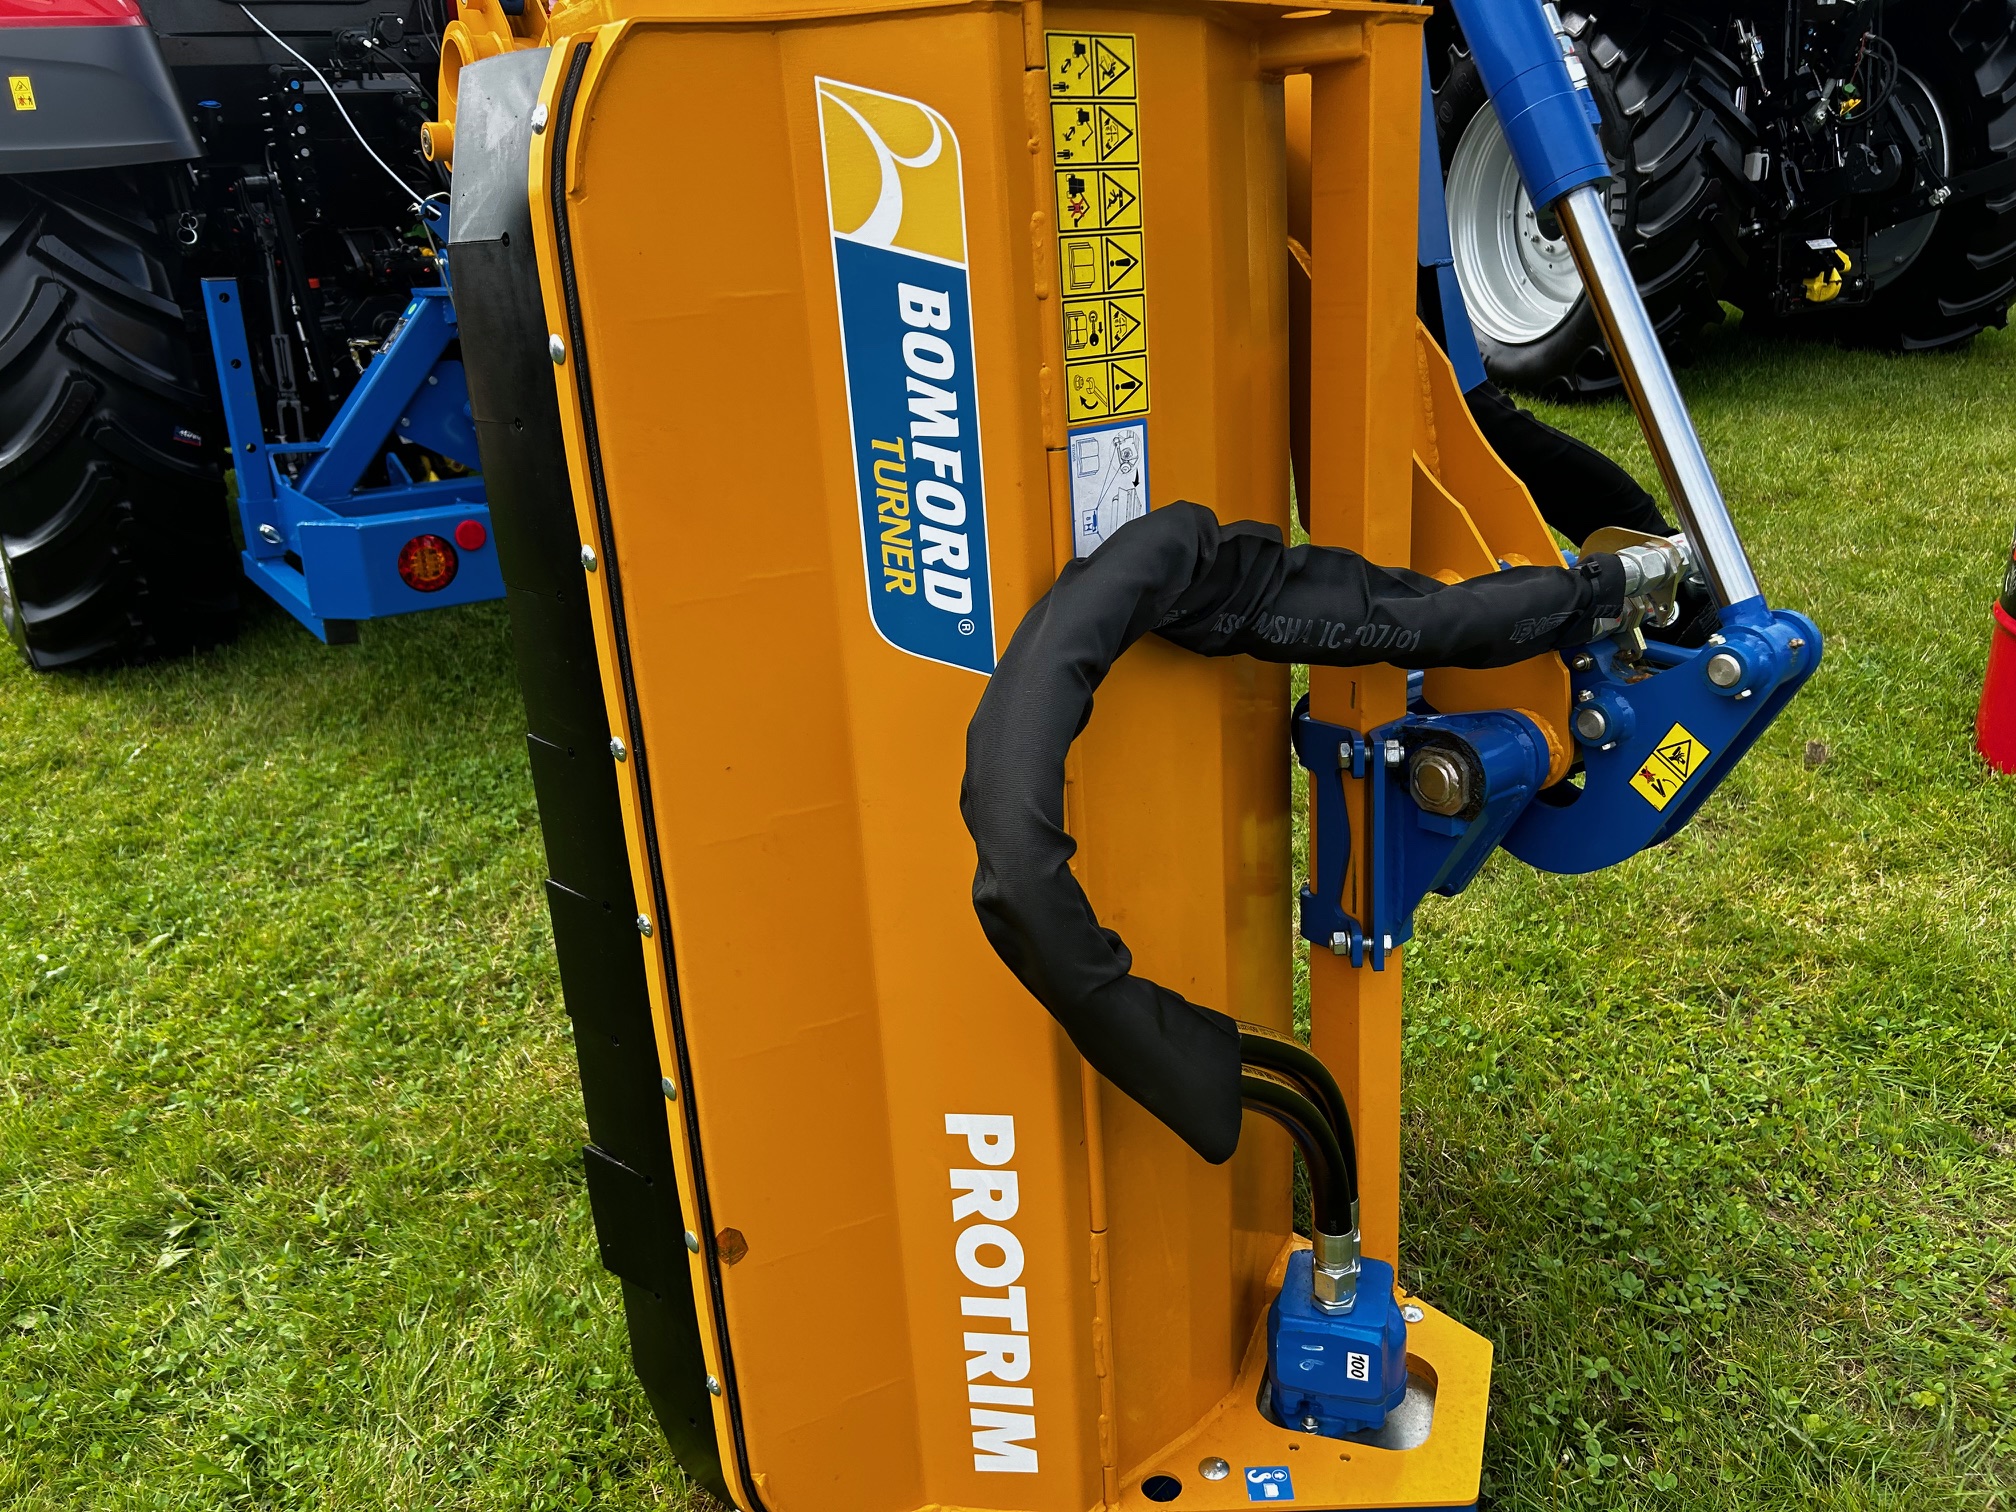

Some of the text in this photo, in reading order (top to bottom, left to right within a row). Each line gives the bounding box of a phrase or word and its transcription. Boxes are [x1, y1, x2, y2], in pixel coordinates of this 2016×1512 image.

[871, 436, 917, 595] TURNER
[1251, 611, 1314, 644] MSHA
[944, 1113, 1039, 1473] PROTRIM
[1350, 1355, 1366, 1379] 100
